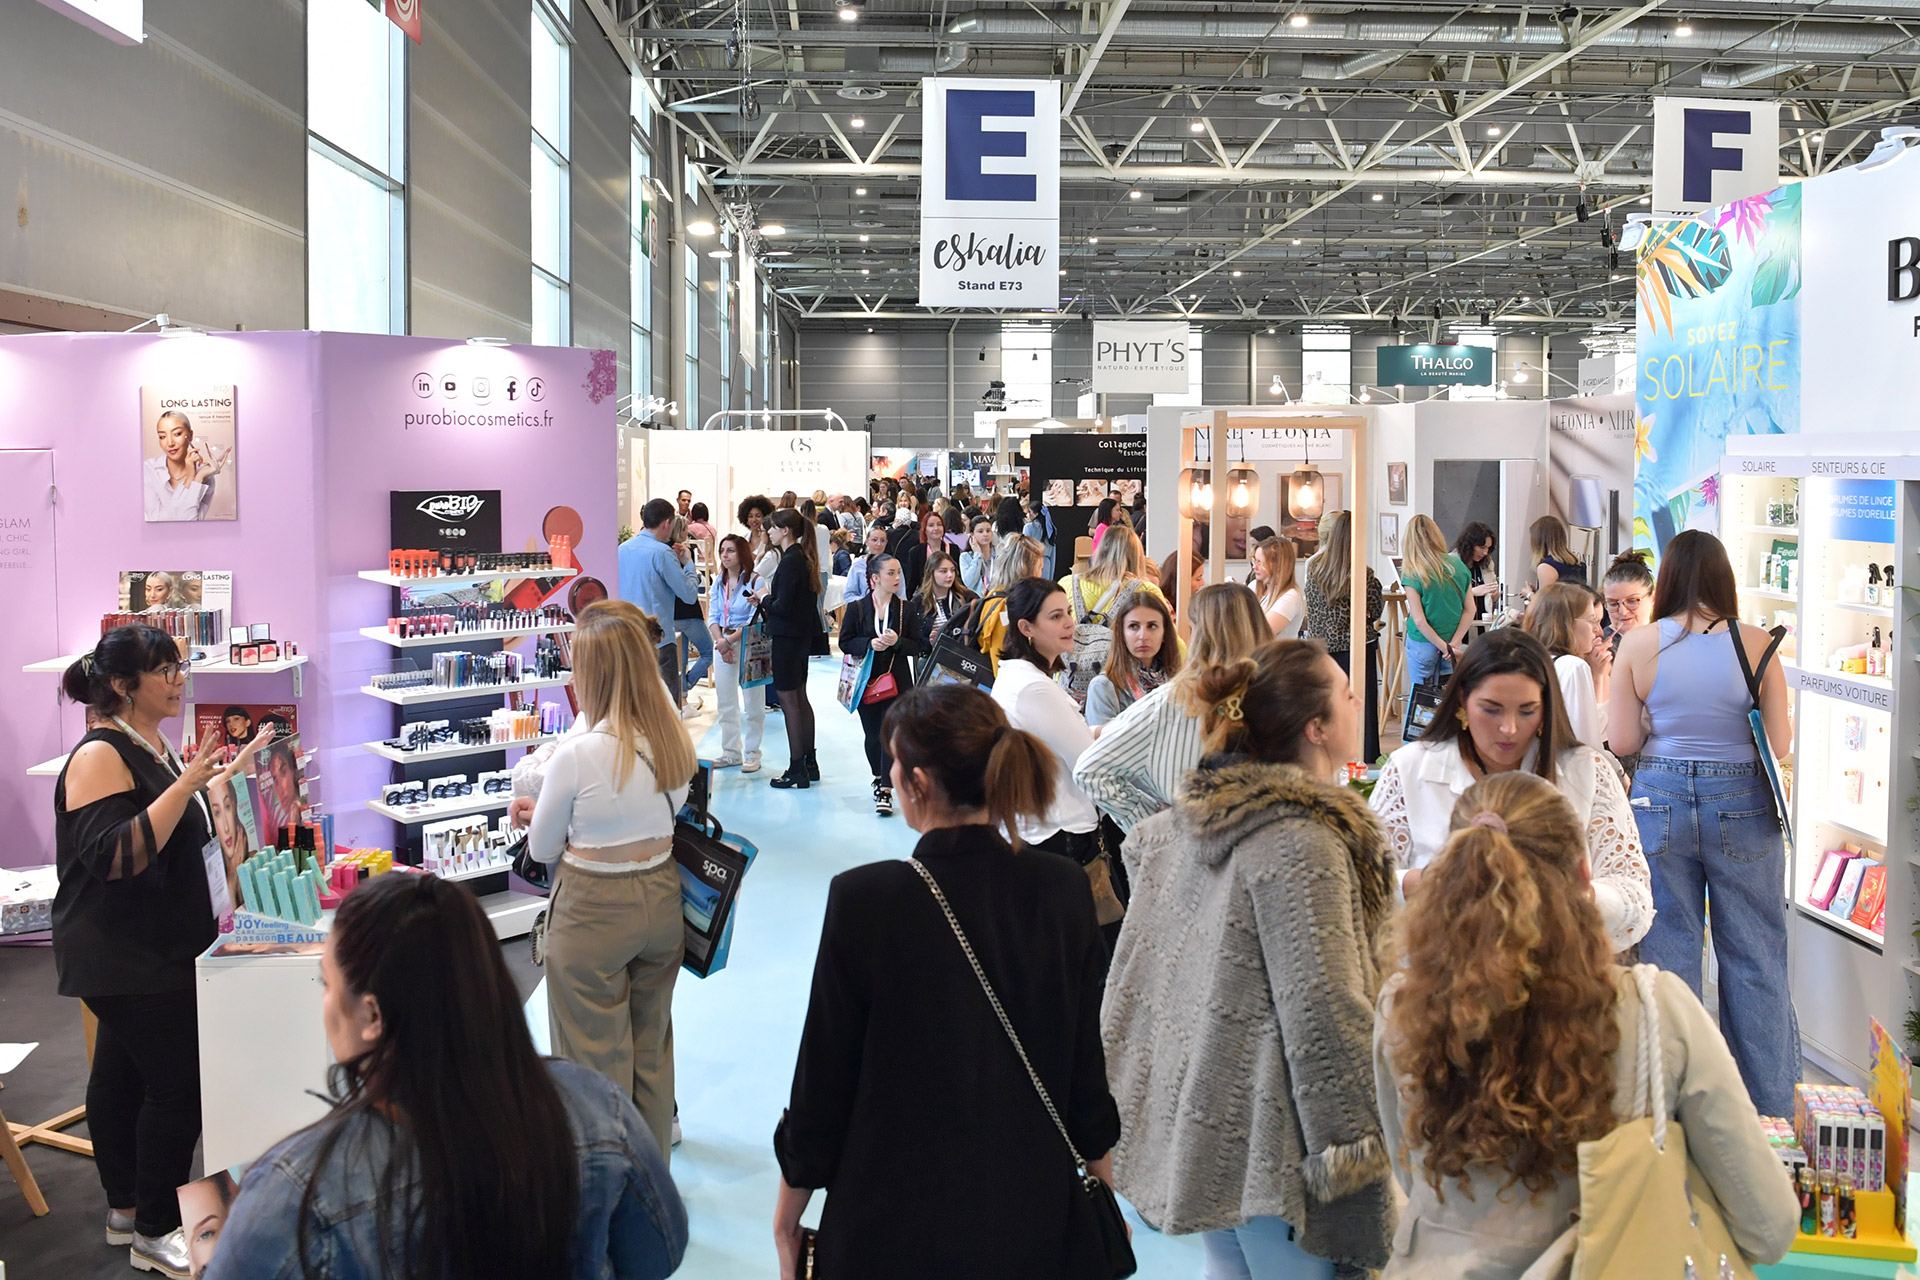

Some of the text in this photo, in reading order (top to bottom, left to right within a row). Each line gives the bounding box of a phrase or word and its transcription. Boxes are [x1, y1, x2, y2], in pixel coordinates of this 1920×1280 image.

[945, 89, 1036, 201] E
[1682, 108, 1751, 203] F
[958, 281, 1022, 290] Stand E73
[1687, 321, 1736, 346] SOYEZ
[1097, 339, 1185, 362] PHYT'S
[1411, 355, 1473, 370] THALGO
[1643, 340, 1789, 401] SOLAIRE
[161, 399, 231, 408] LONG LASTING
[405, 408, 553, 430] purobiocosmetics.fr
[1742, 461, 1776, 472] SOLAIRE
[1812, 462, 1886, 474] SENTEURS & CIE
[1859, 495, 1869, 505] DE
[1870, 496, 1893, 506] LINGE
[1830, 508, 1856, 518] RUMES
[203, 573, 230, 581] LASTING
[960, 659, 977, 672] spa
[1800, 675, 1888, 707] PARFUMS VOITURE
[702, 859, 727, 877] spa
[235, 919, 289, 930] JOY feeling
[235, 933, 329, 943] passion BEAUT
